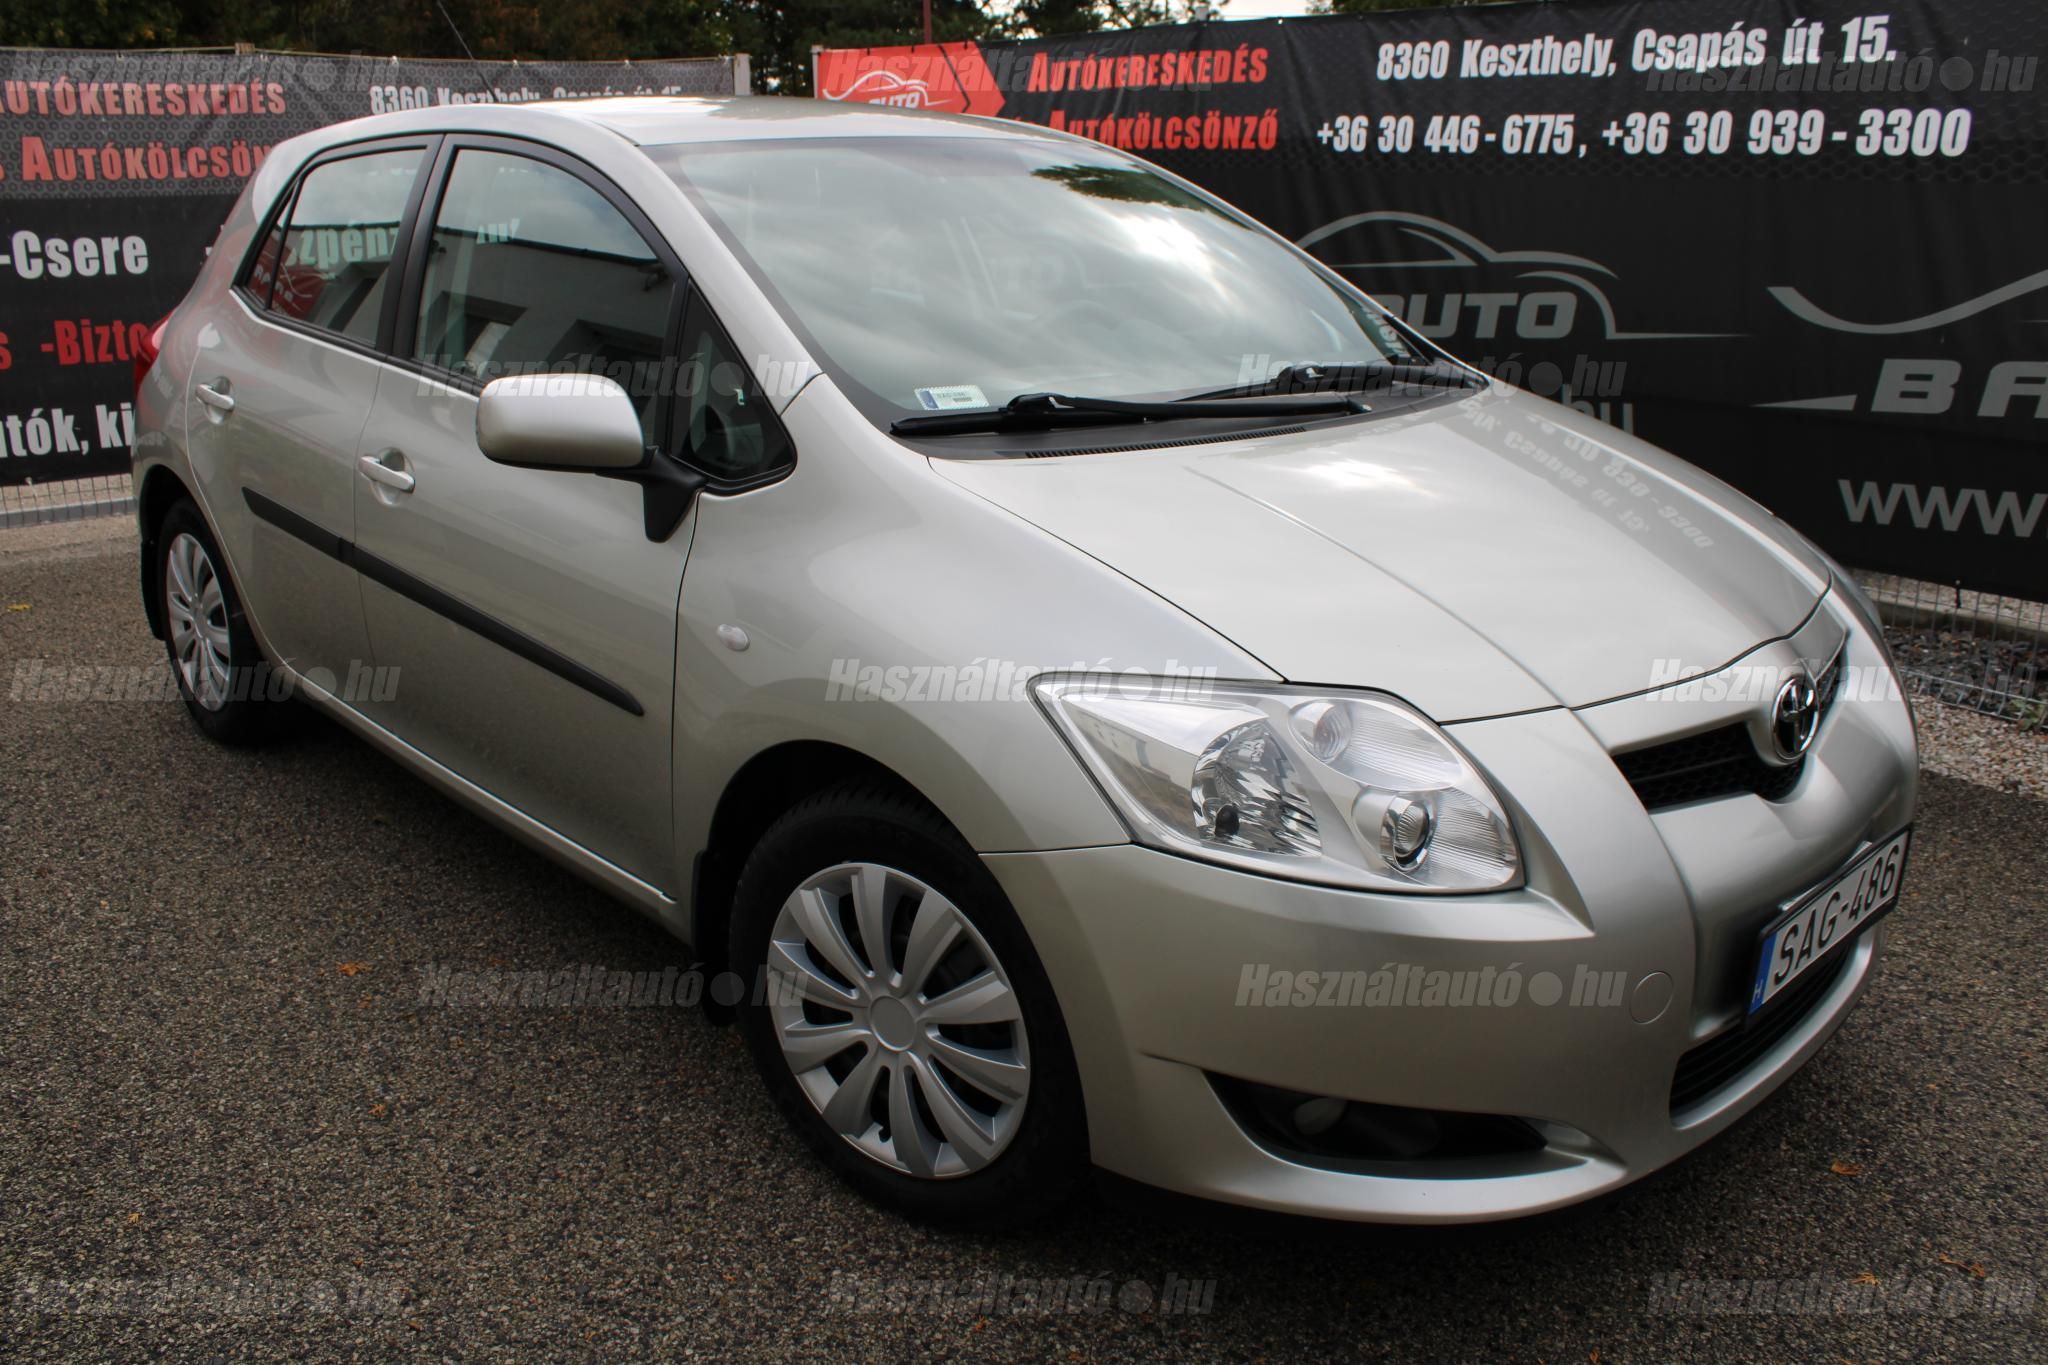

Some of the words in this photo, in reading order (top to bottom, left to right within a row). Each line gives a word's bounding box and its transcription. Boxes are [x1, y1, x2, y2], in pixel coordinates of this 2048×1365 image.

[1027, 43, 1268, 93] AUTÓKERESKEDÉS
[1376, 40, 1449, 80] 8360
[1460, 33, 1616, 78] Keszthely,
[1632, 21, 1768, 73] Csapás
[1782, 18, 1824, 65] út
[1841, 15, 1897, 63] 15.
[0, 75, 286, 116] UTÓKERESKEDÉS
[1317, 115, 1369, 153] +36
[1377, 115, 1414, 153] 30
[1602, 112, 1671, 155] +36
[1683, 110, 1733, 155] 30
[0, 408, 89, 457] tók,
[1774, 844, 1899, 985] SAG-486
